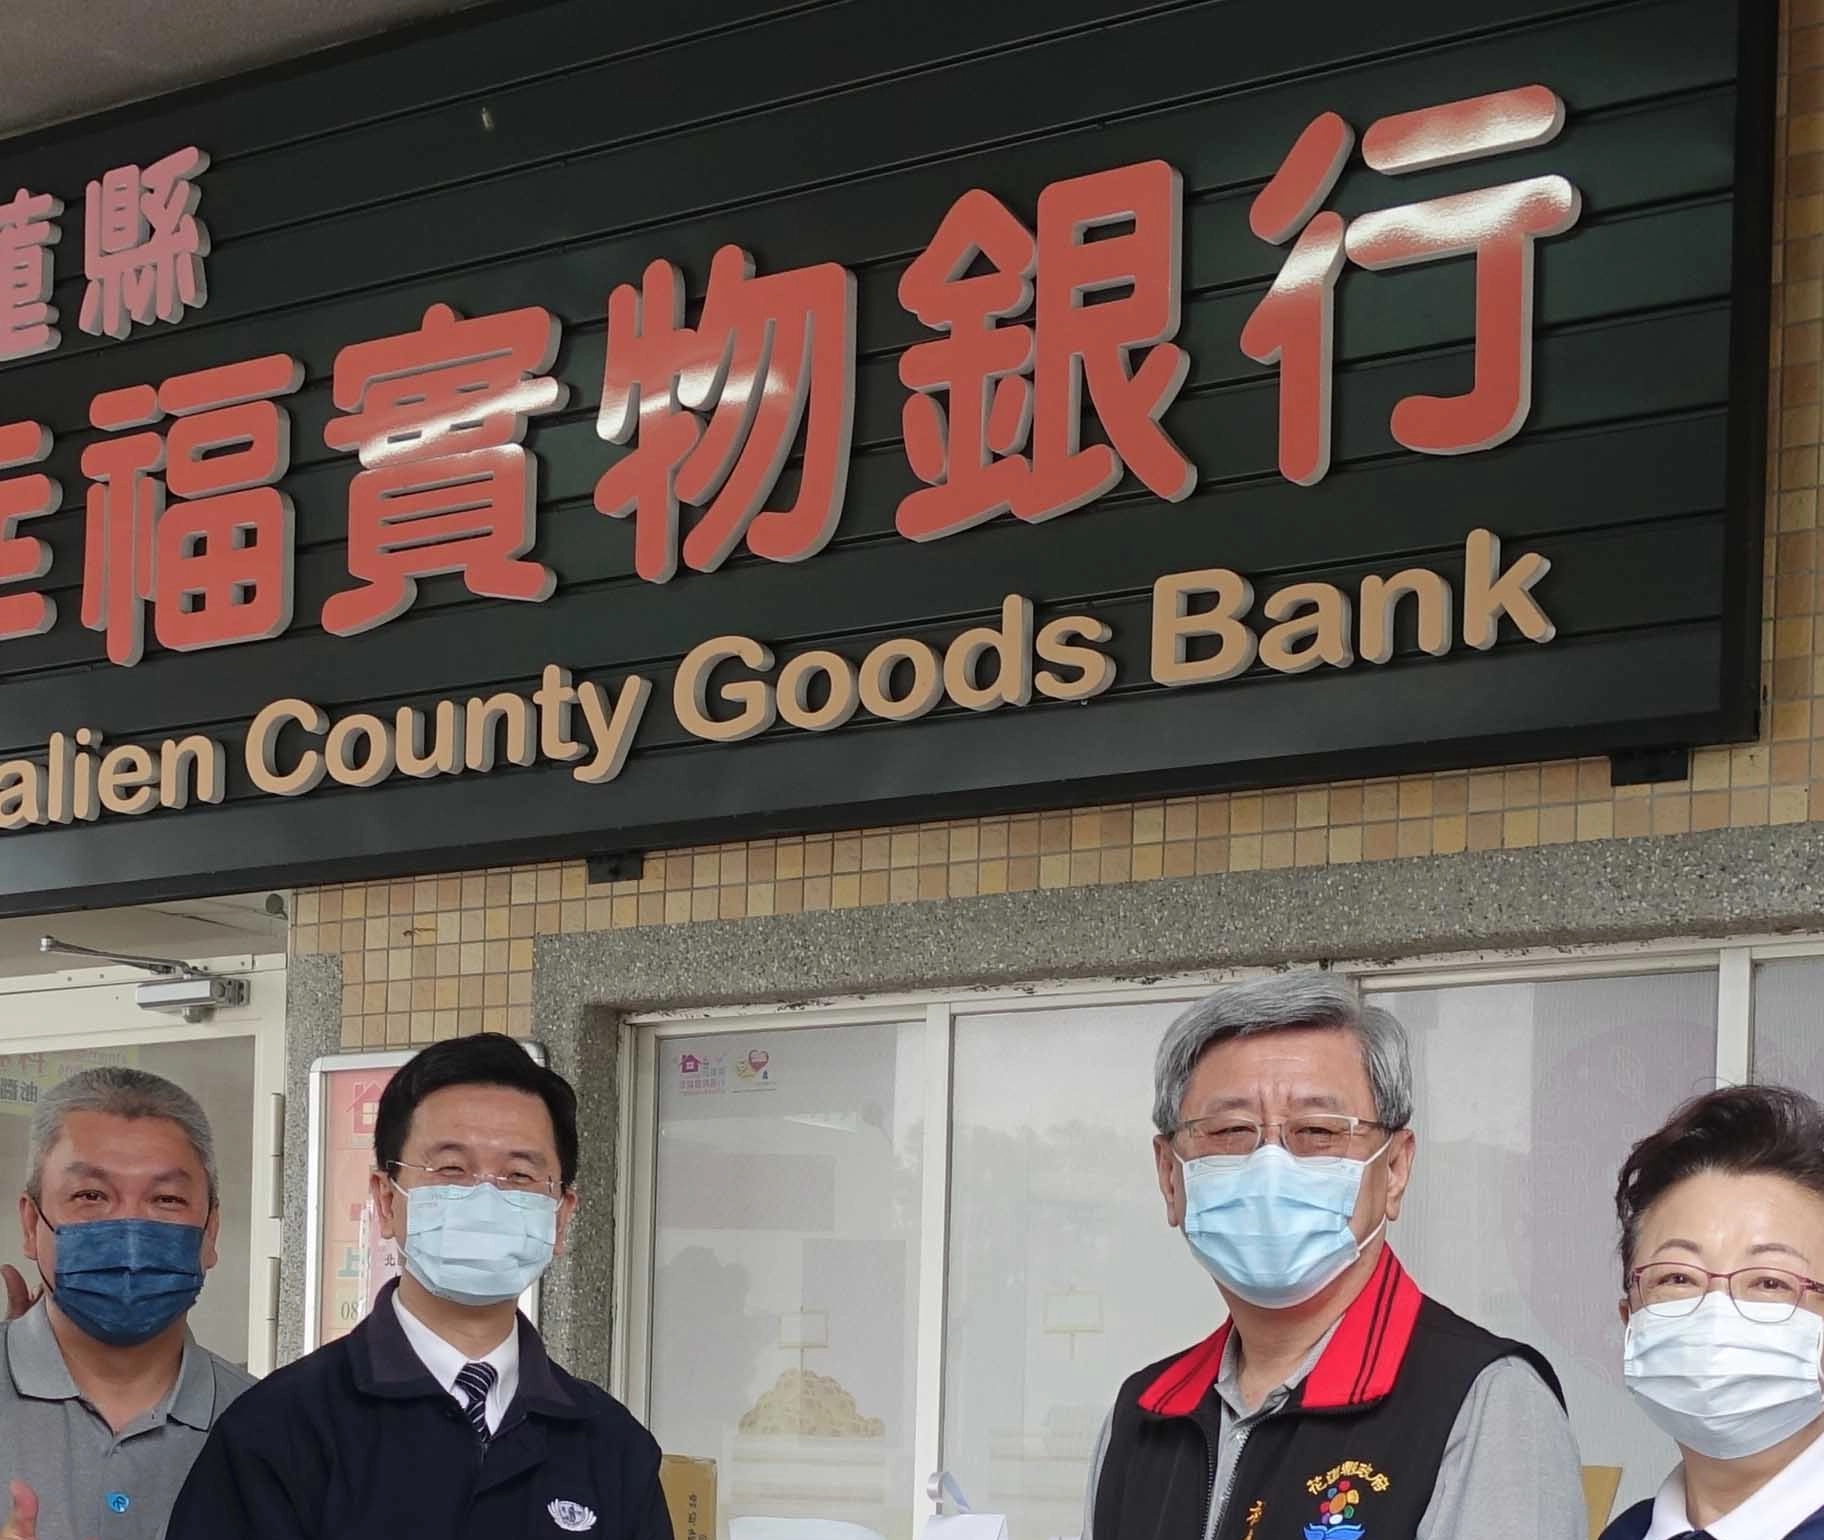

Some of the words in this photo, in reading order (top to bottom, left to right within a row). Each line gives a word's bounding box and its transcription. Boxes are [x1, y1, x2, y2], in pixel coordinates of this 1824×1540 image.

[242, 664, 650, 798] County
[670, 592, 1116, 746] Goods
[1148, 528, 1556, 688] Bank
